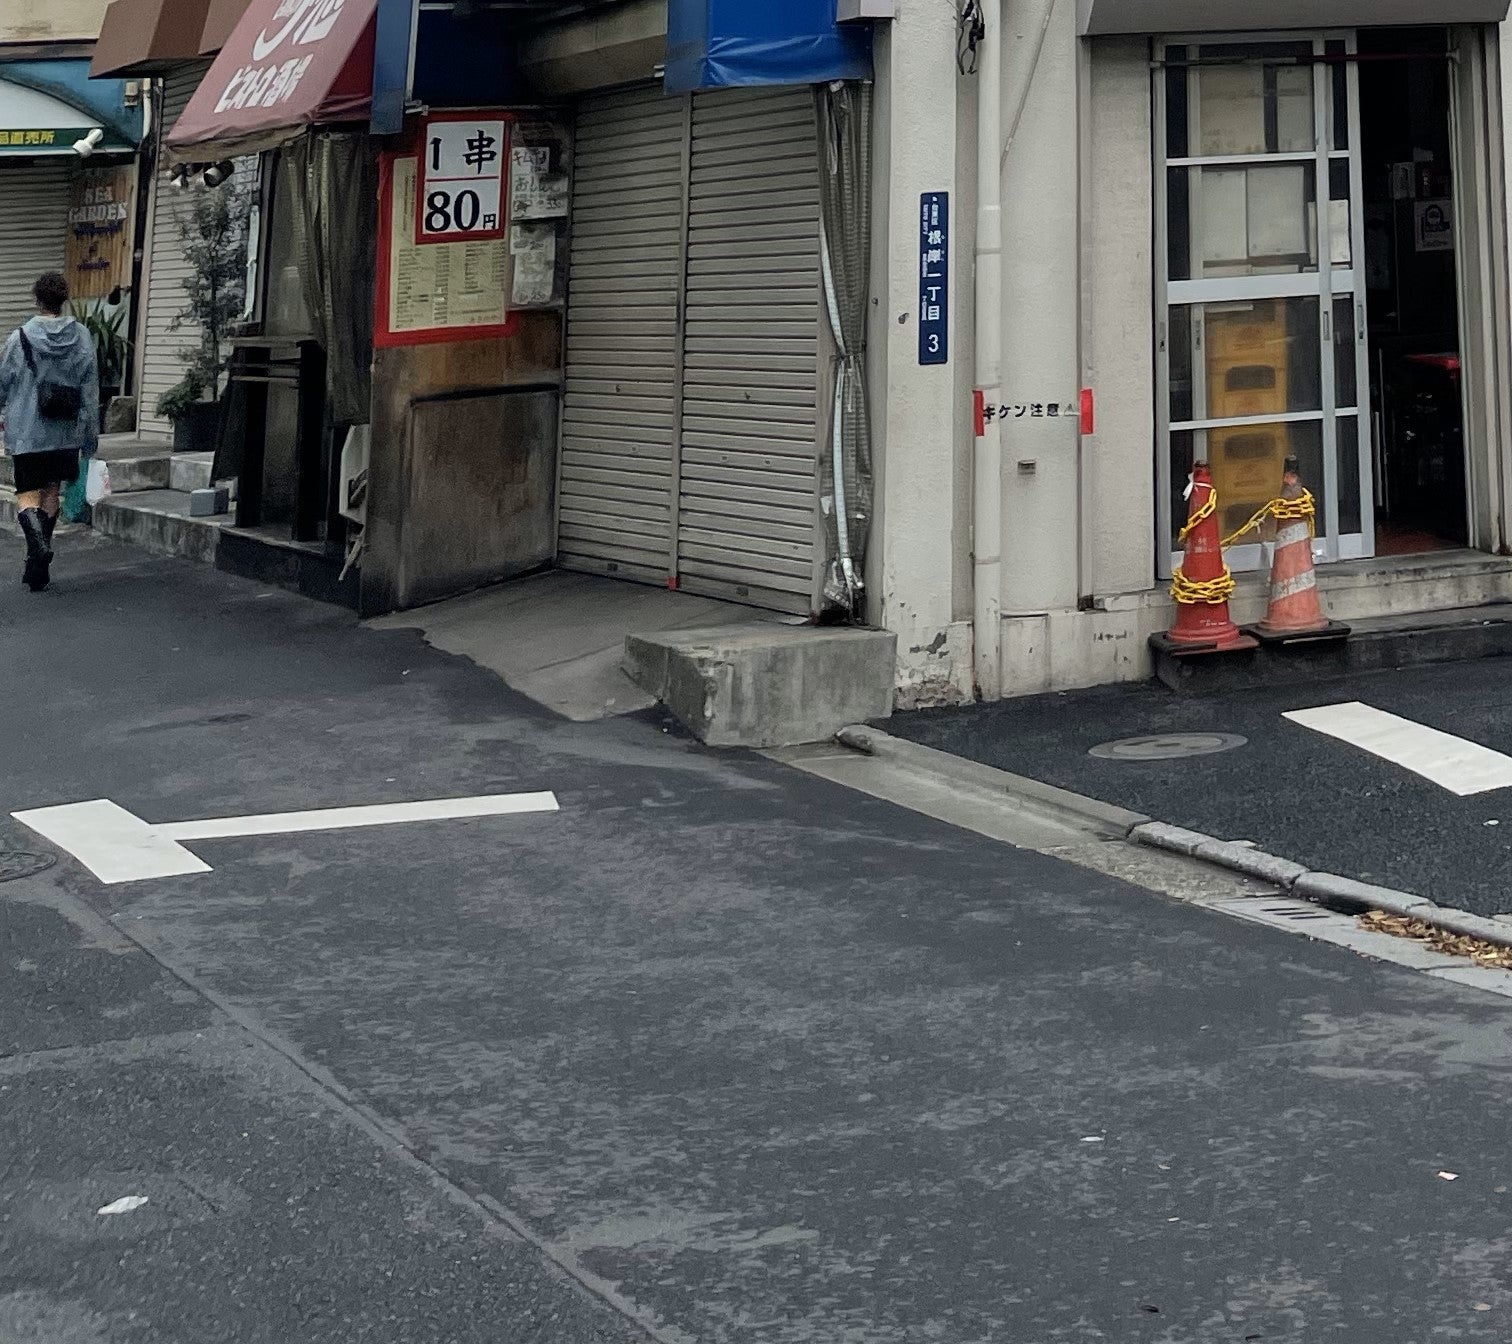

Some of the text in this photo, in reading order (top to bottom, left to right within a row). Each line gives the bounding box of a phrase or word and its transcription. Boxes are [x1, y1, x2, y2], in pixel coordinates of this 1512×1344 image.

[214, 53, 313, 113] ビストロ酒場
[425, 189, 497, 233] 80円
[928, 333, 939, 353] 3
[982, 403, 1059, 424] キケン注意
